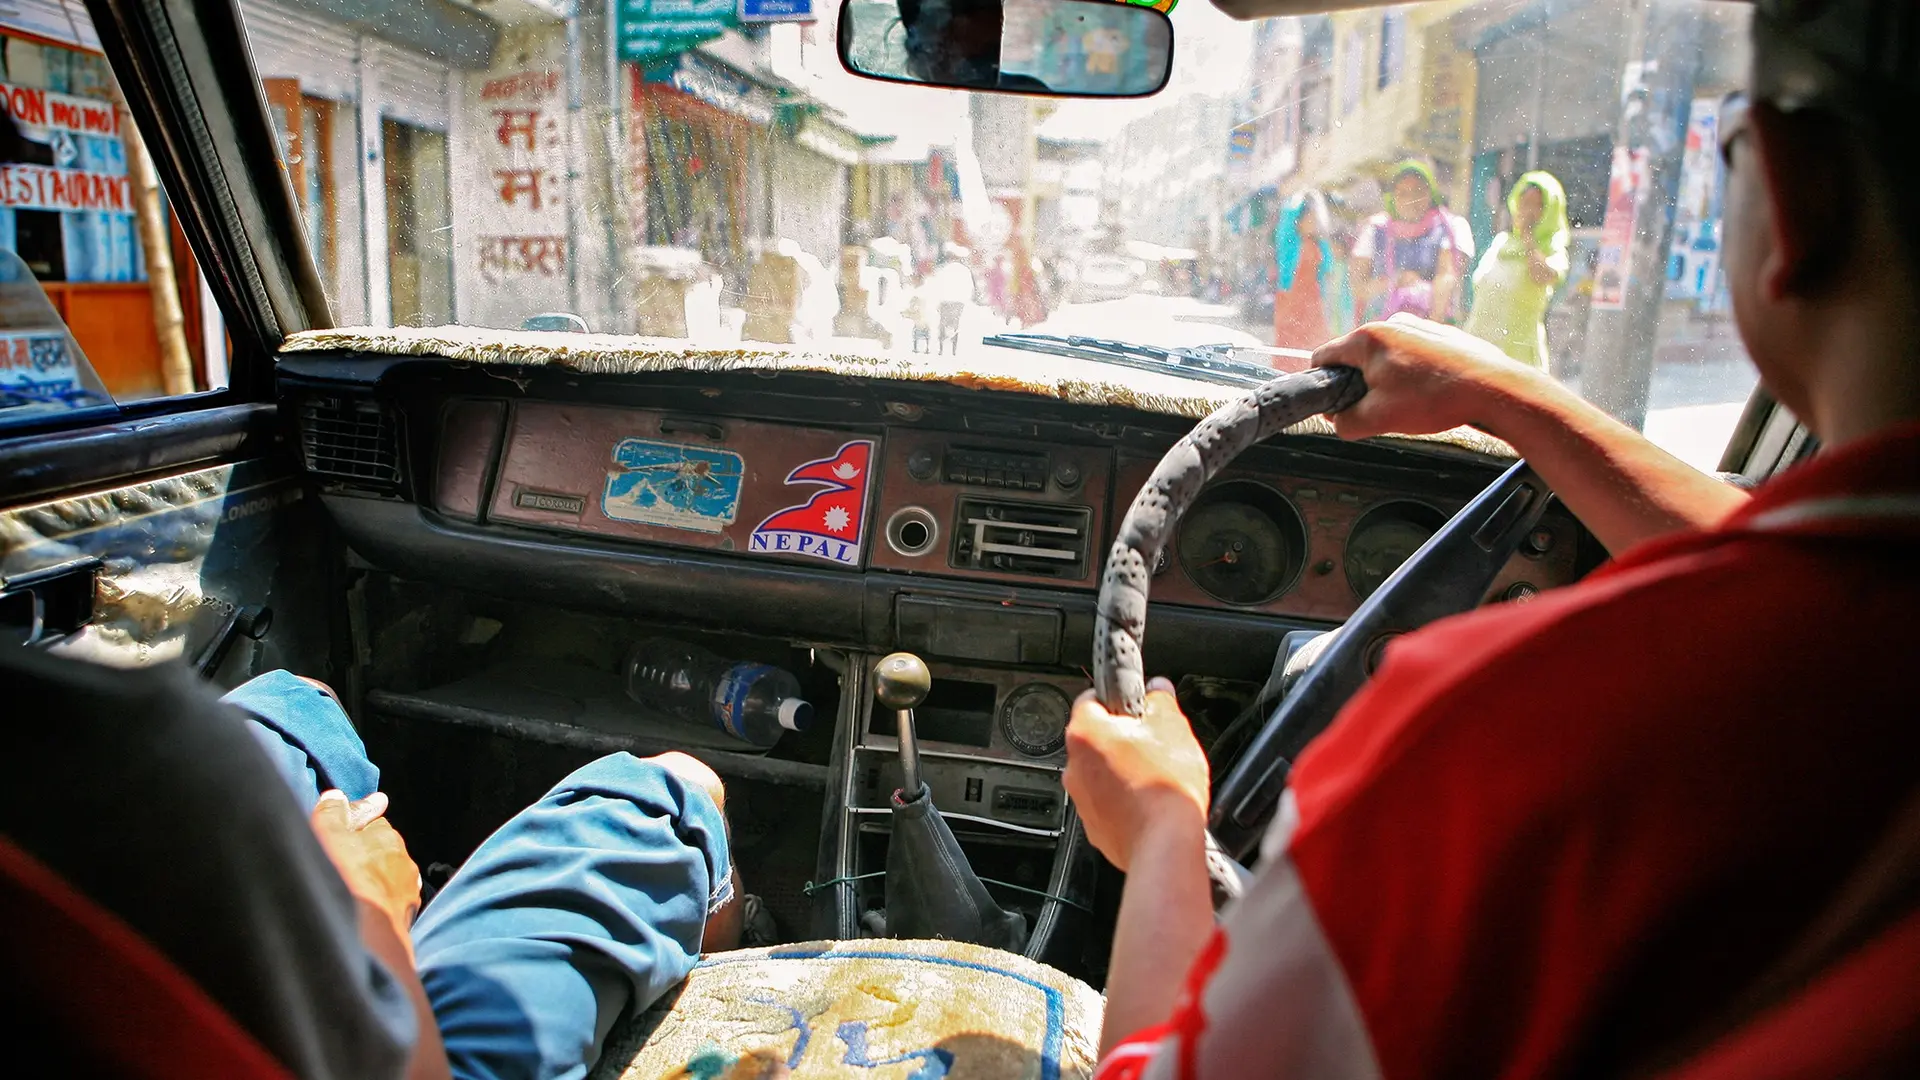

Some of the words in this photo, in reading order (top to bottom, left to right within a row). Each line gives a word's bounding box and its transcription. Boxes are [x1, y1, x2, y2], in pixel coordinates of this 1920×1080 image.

[0, 166, 135, 209] ESTAURANT
[539, 498, 577, 511] COROLLA
[751, 533, 852, 562] NEPAL
